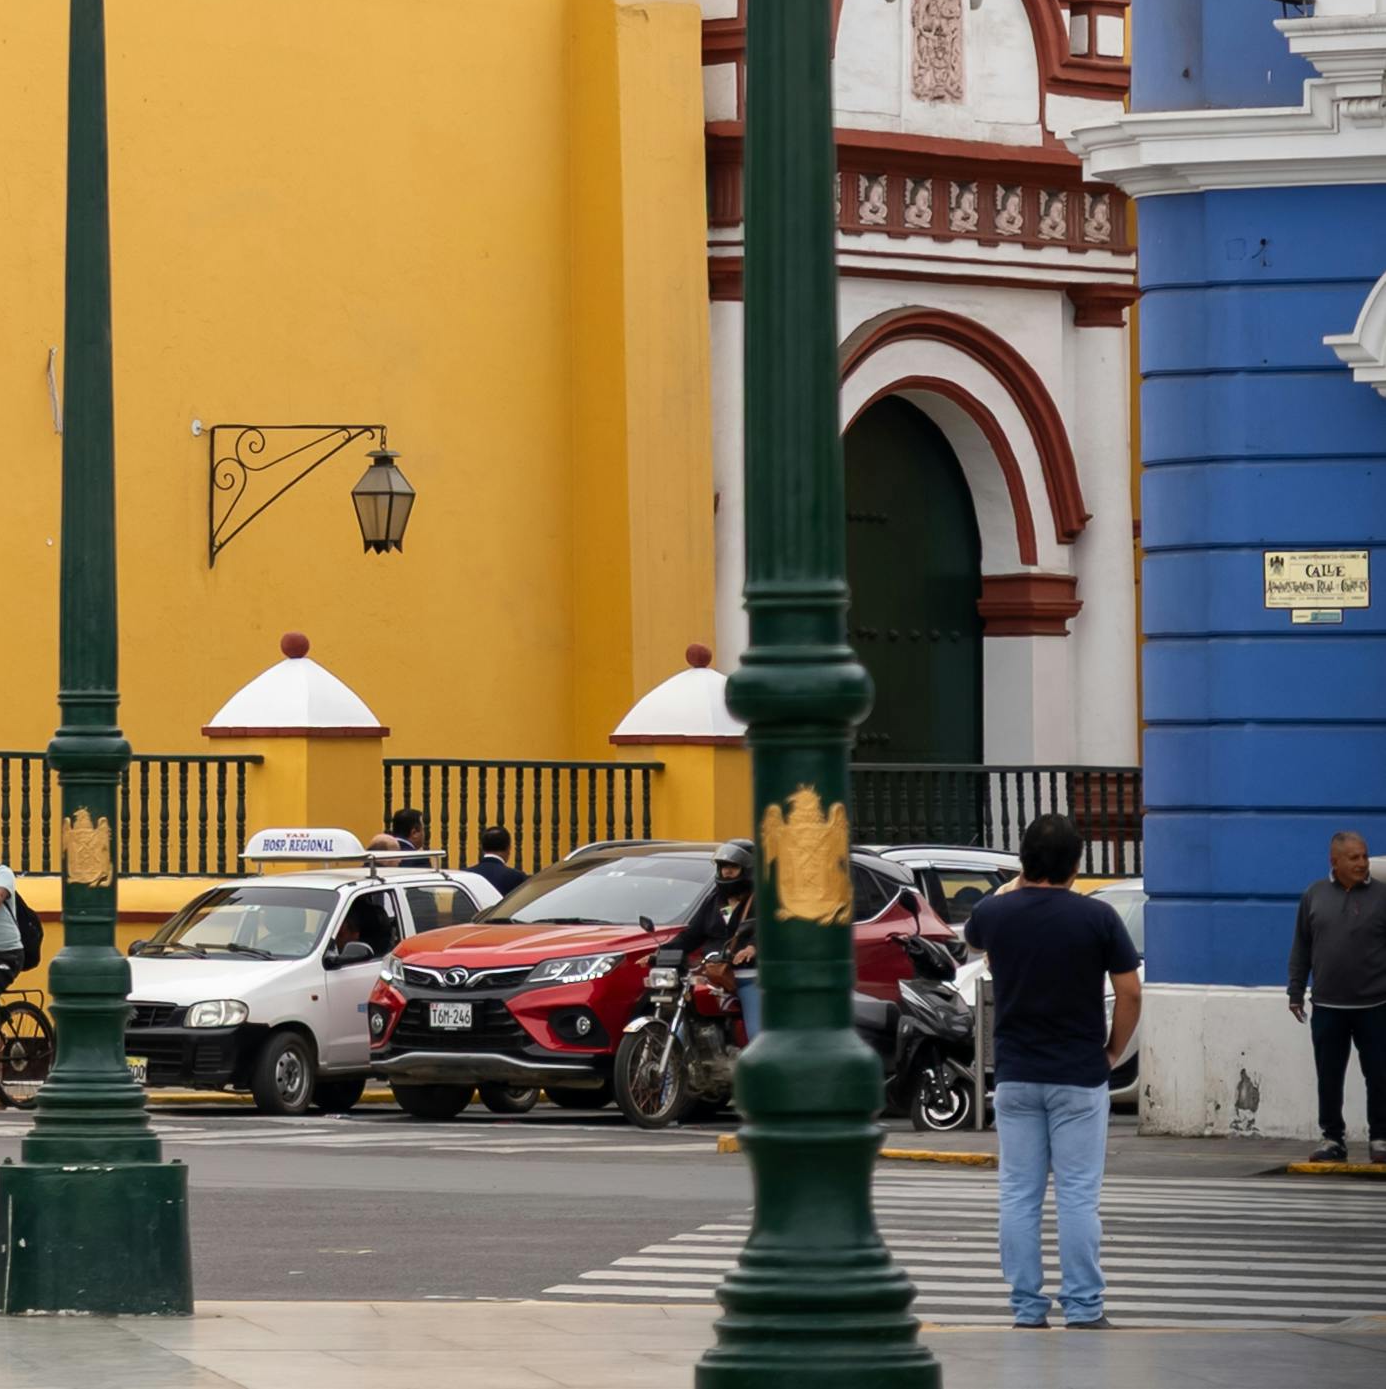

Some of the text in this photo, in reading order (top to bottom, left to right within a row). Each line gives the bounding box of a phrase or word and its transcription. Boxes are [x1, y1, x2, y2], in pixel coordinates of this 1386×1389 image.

[1305, 564, 1346, 578] CALLE
[262, 839, 334, 852] HOSP. REGIONAL
[432, 1009, 471, 1024] T6M-246
